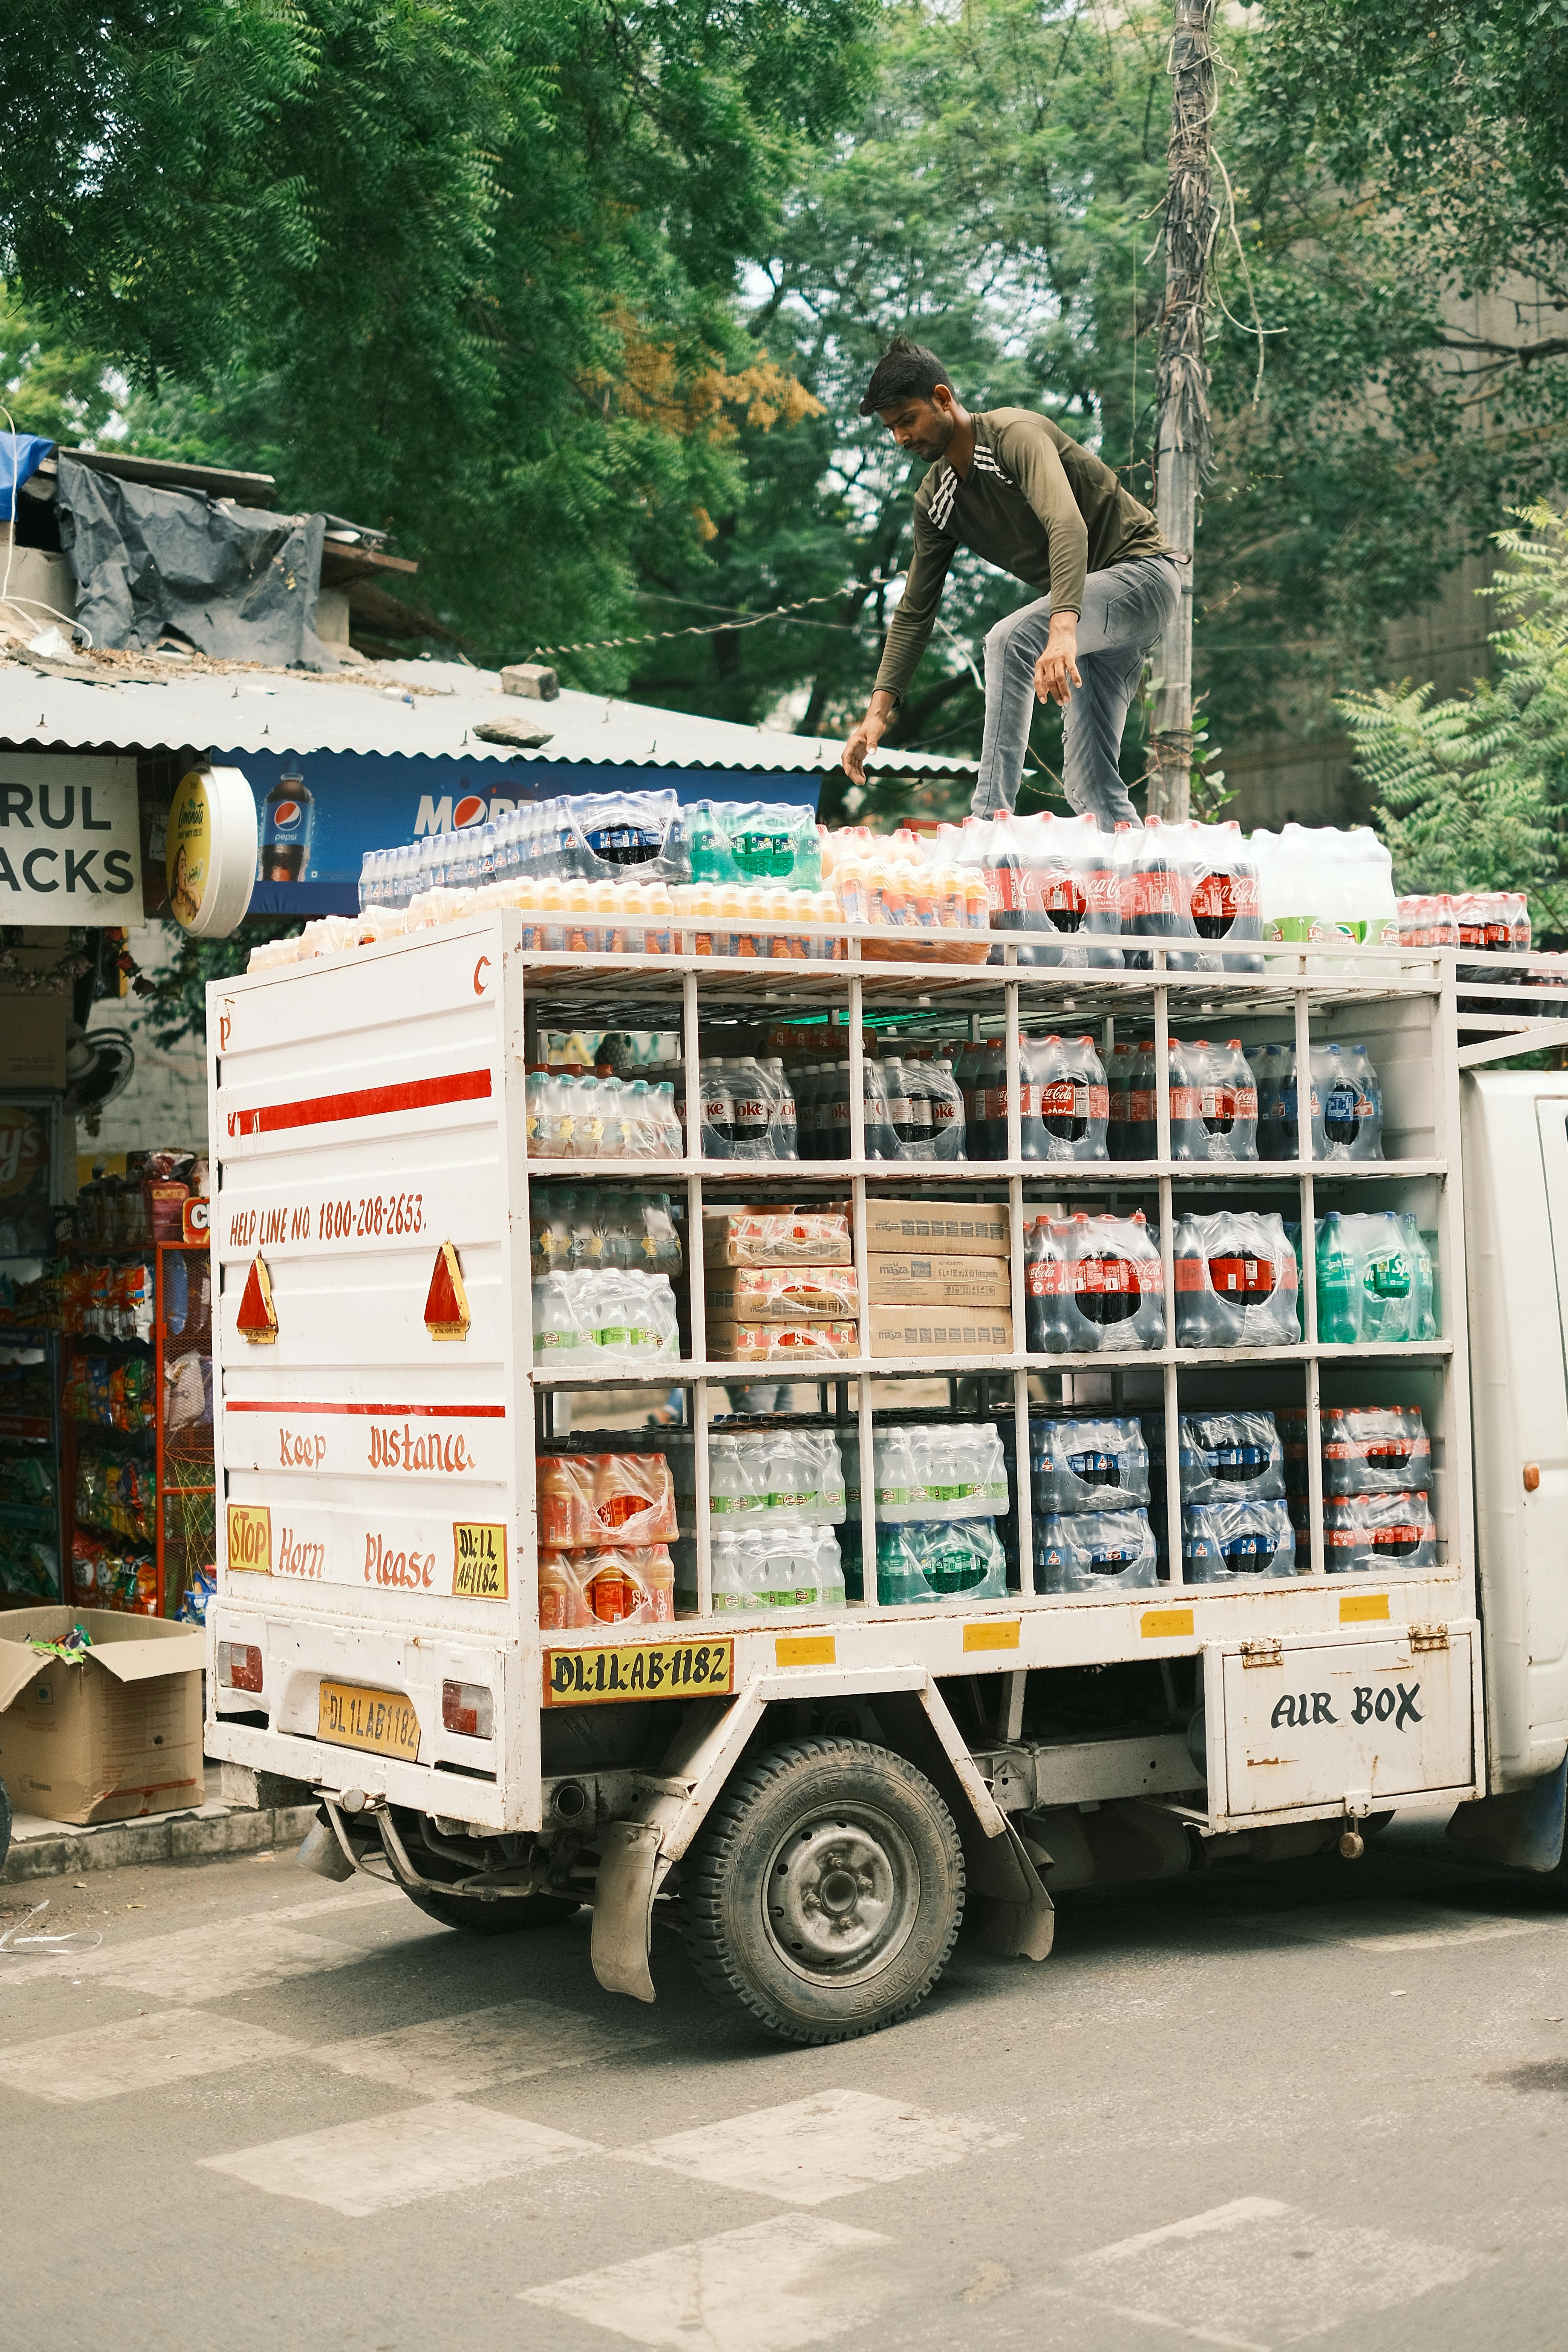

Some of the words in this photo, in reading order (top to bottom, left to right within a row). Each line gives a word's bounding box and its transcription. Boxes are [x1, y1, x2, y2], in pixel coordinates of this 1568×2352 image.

[474, 956, 492, 996] C
[707, 1103, 724, 1116] ke
[736, 1101, 764, 1117] oke
[933, 1104, 955, 1119] oke
[230, 1210, 256, 1247] HELP
[259, 1208, 288, 1245] LINE
[879, 1266, 908, 1276] maaza
[975, 1270, 998, 1279] Tetrapacks
[879, 1332, 902, 1340] maaza
[280, 1428, 327, 1469] Keep
[279, 1527, 325, 1579] Horn
[364, 1532, 436, 1589] Please
[322, 1706, 331, 1716] IND
[1271, 1692, 1341, 1729] AIR
[1351, 1682, 1426, 1733] BOX
[774, 1775, 842, 1828] MRF
[850, 1959, 916, 2015] MRF
